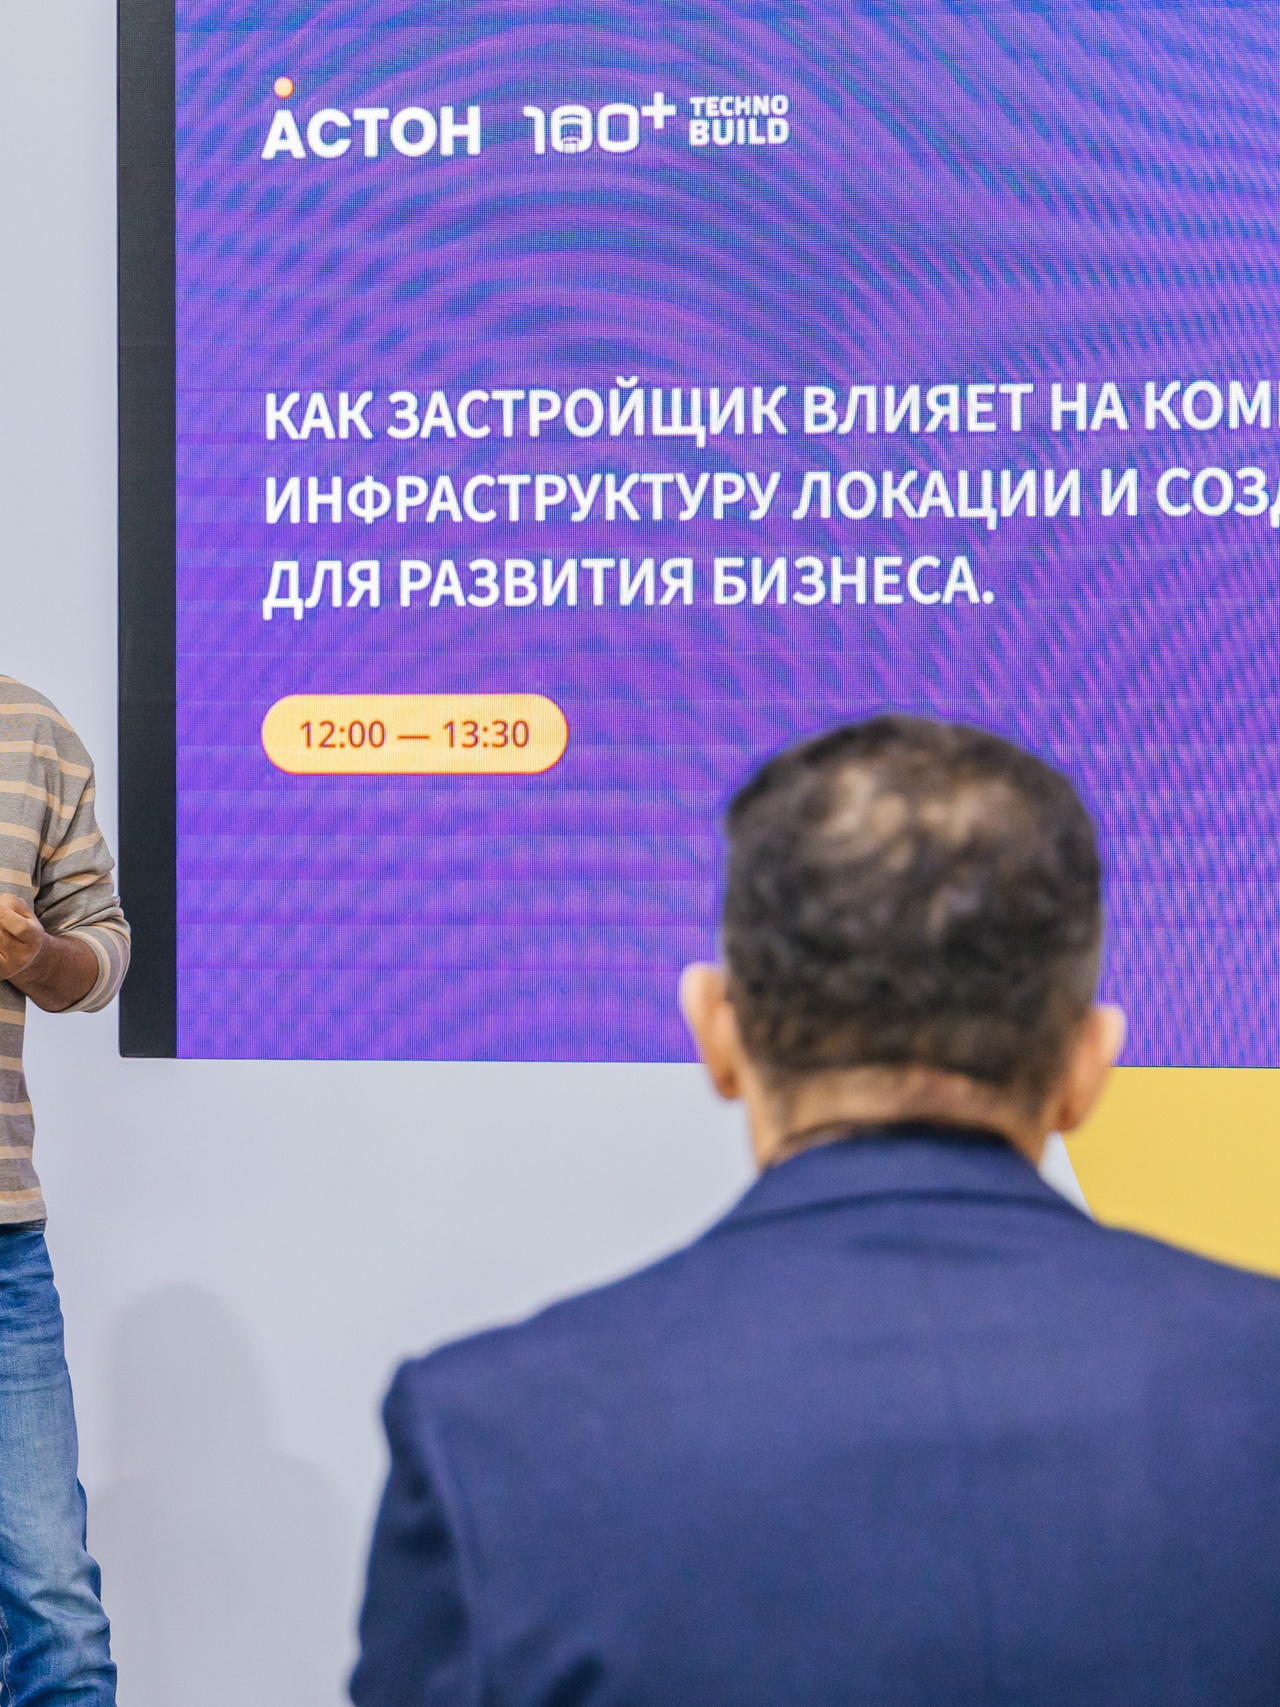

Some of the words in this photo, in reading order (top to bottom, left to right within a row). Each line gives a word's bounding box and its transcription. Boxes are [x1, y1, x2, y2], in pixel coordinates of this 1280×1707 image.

[261, 105, 481, 159] АСТОН
[689, 94, 790, 117] TECHNO
[689, 118, 790, 146] BUILD
[265, 390, 373, 440] КАК
[387, 376, 788, 448] ЗАСТРОЙЩИК
[804, 383, 1034, 434] ВЛИЯЕТ
[1051, 382, 1129, 432] НА
[1145, 380, 1280, 431] КОМ
[265, 472, 780, 524] ИНФРАСТРУКТУРУ
[792, 468, 1080, 530] ЛОКАЦИИ
[1101, 468, 1138, 517] И
[1156, 466, 1280, 529] СОЗ
[262, 559, 380, 621] ДЛЯ
[400, 557, 694, 608] РАЗВИТИЯ
[714, 555, 995, 606] БИЗНЕСА.
[300, 719, 387, 748] 12:00
[443, 719, 529, 748] 13:30
